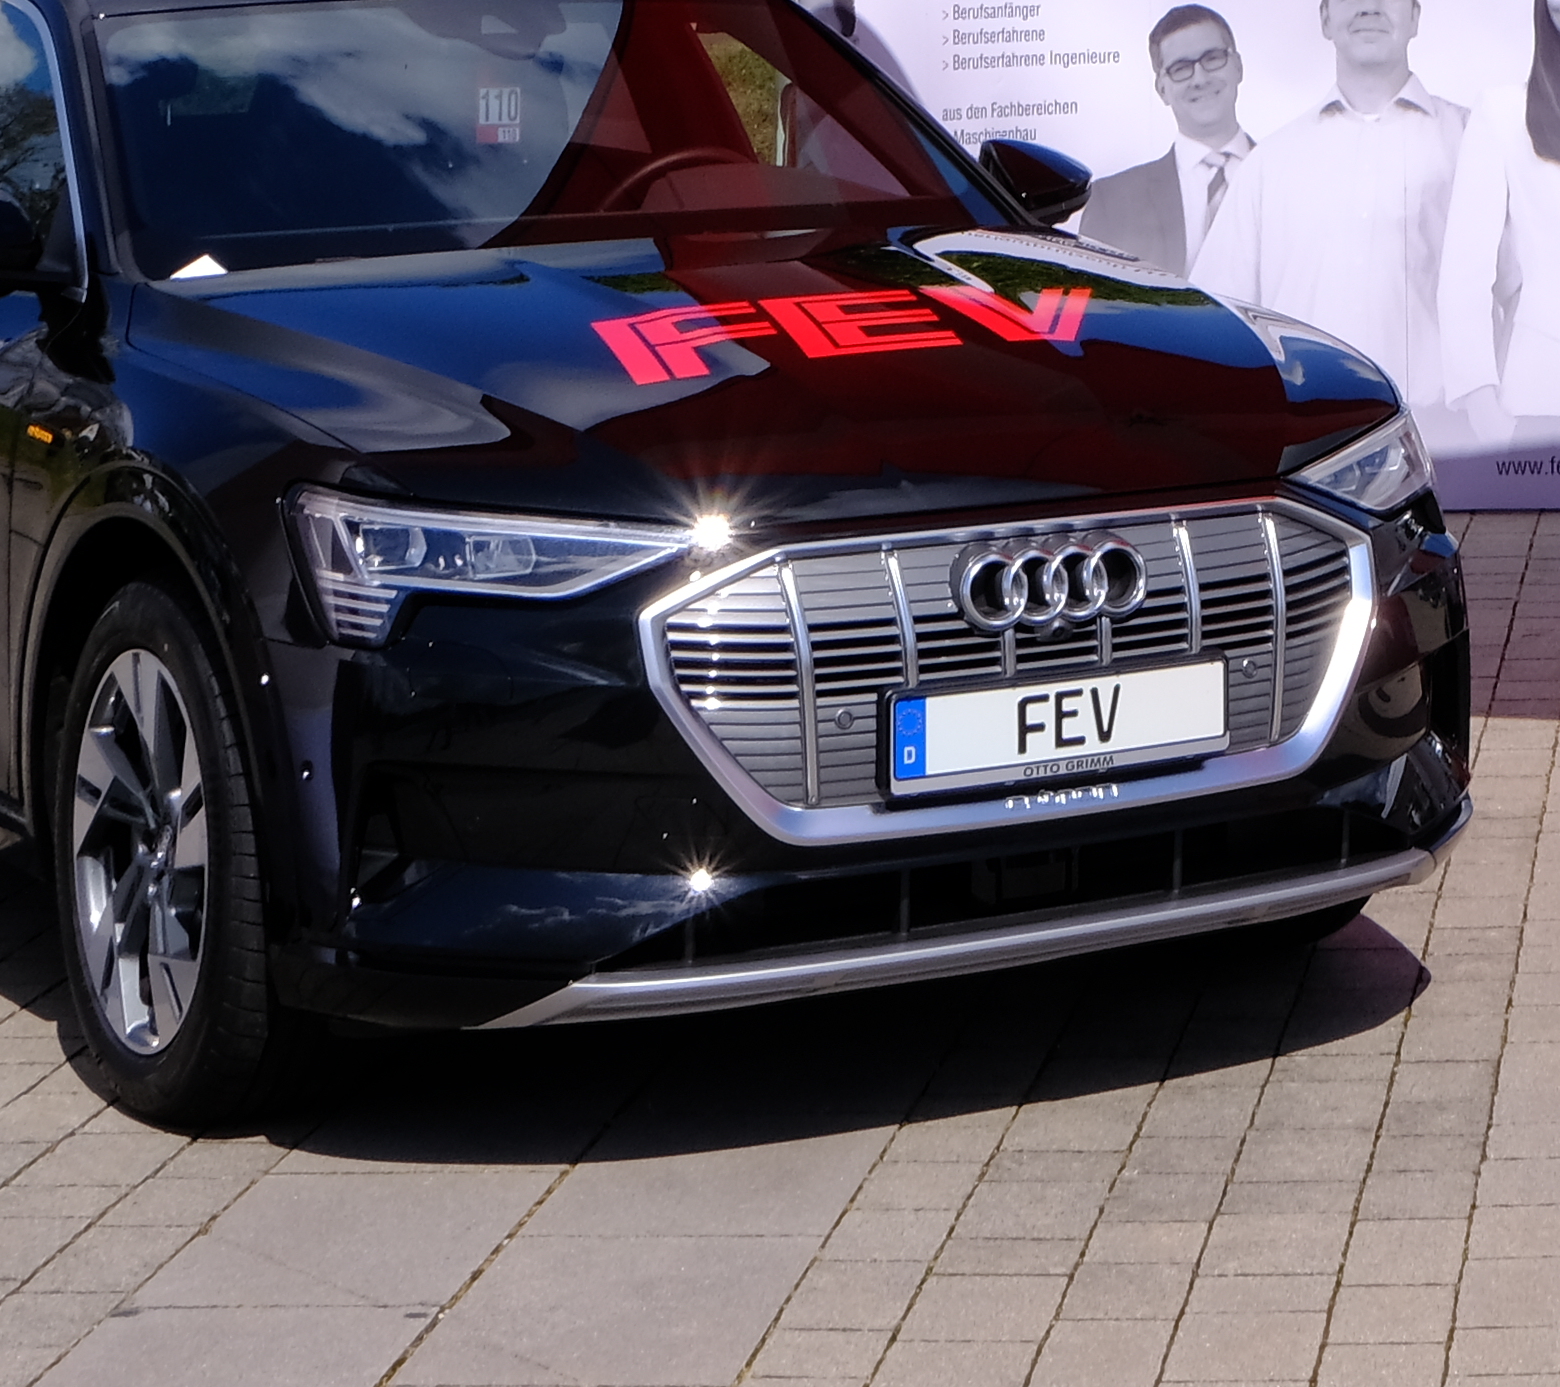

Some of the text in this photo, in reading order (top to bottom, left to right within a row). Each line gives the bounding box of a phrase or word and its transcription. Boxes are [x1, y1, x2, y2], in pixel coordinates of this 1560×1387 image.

[952, 3, 1041, 21] Berufsanfänger
[952, 27, 1045, 45] Berufserfahrene
[952, 49, 1120, 71] Berufserfahrene Ingenieure
[942, 100, 1078, 121] aus den Fachbereichen
[590, 288, 1093, 386] FEV
[1017, 683, 1121, 755] FEV
[903, 746, 916, 764] D
[1023, 755, 1114, 777] OTTO GRIMM
